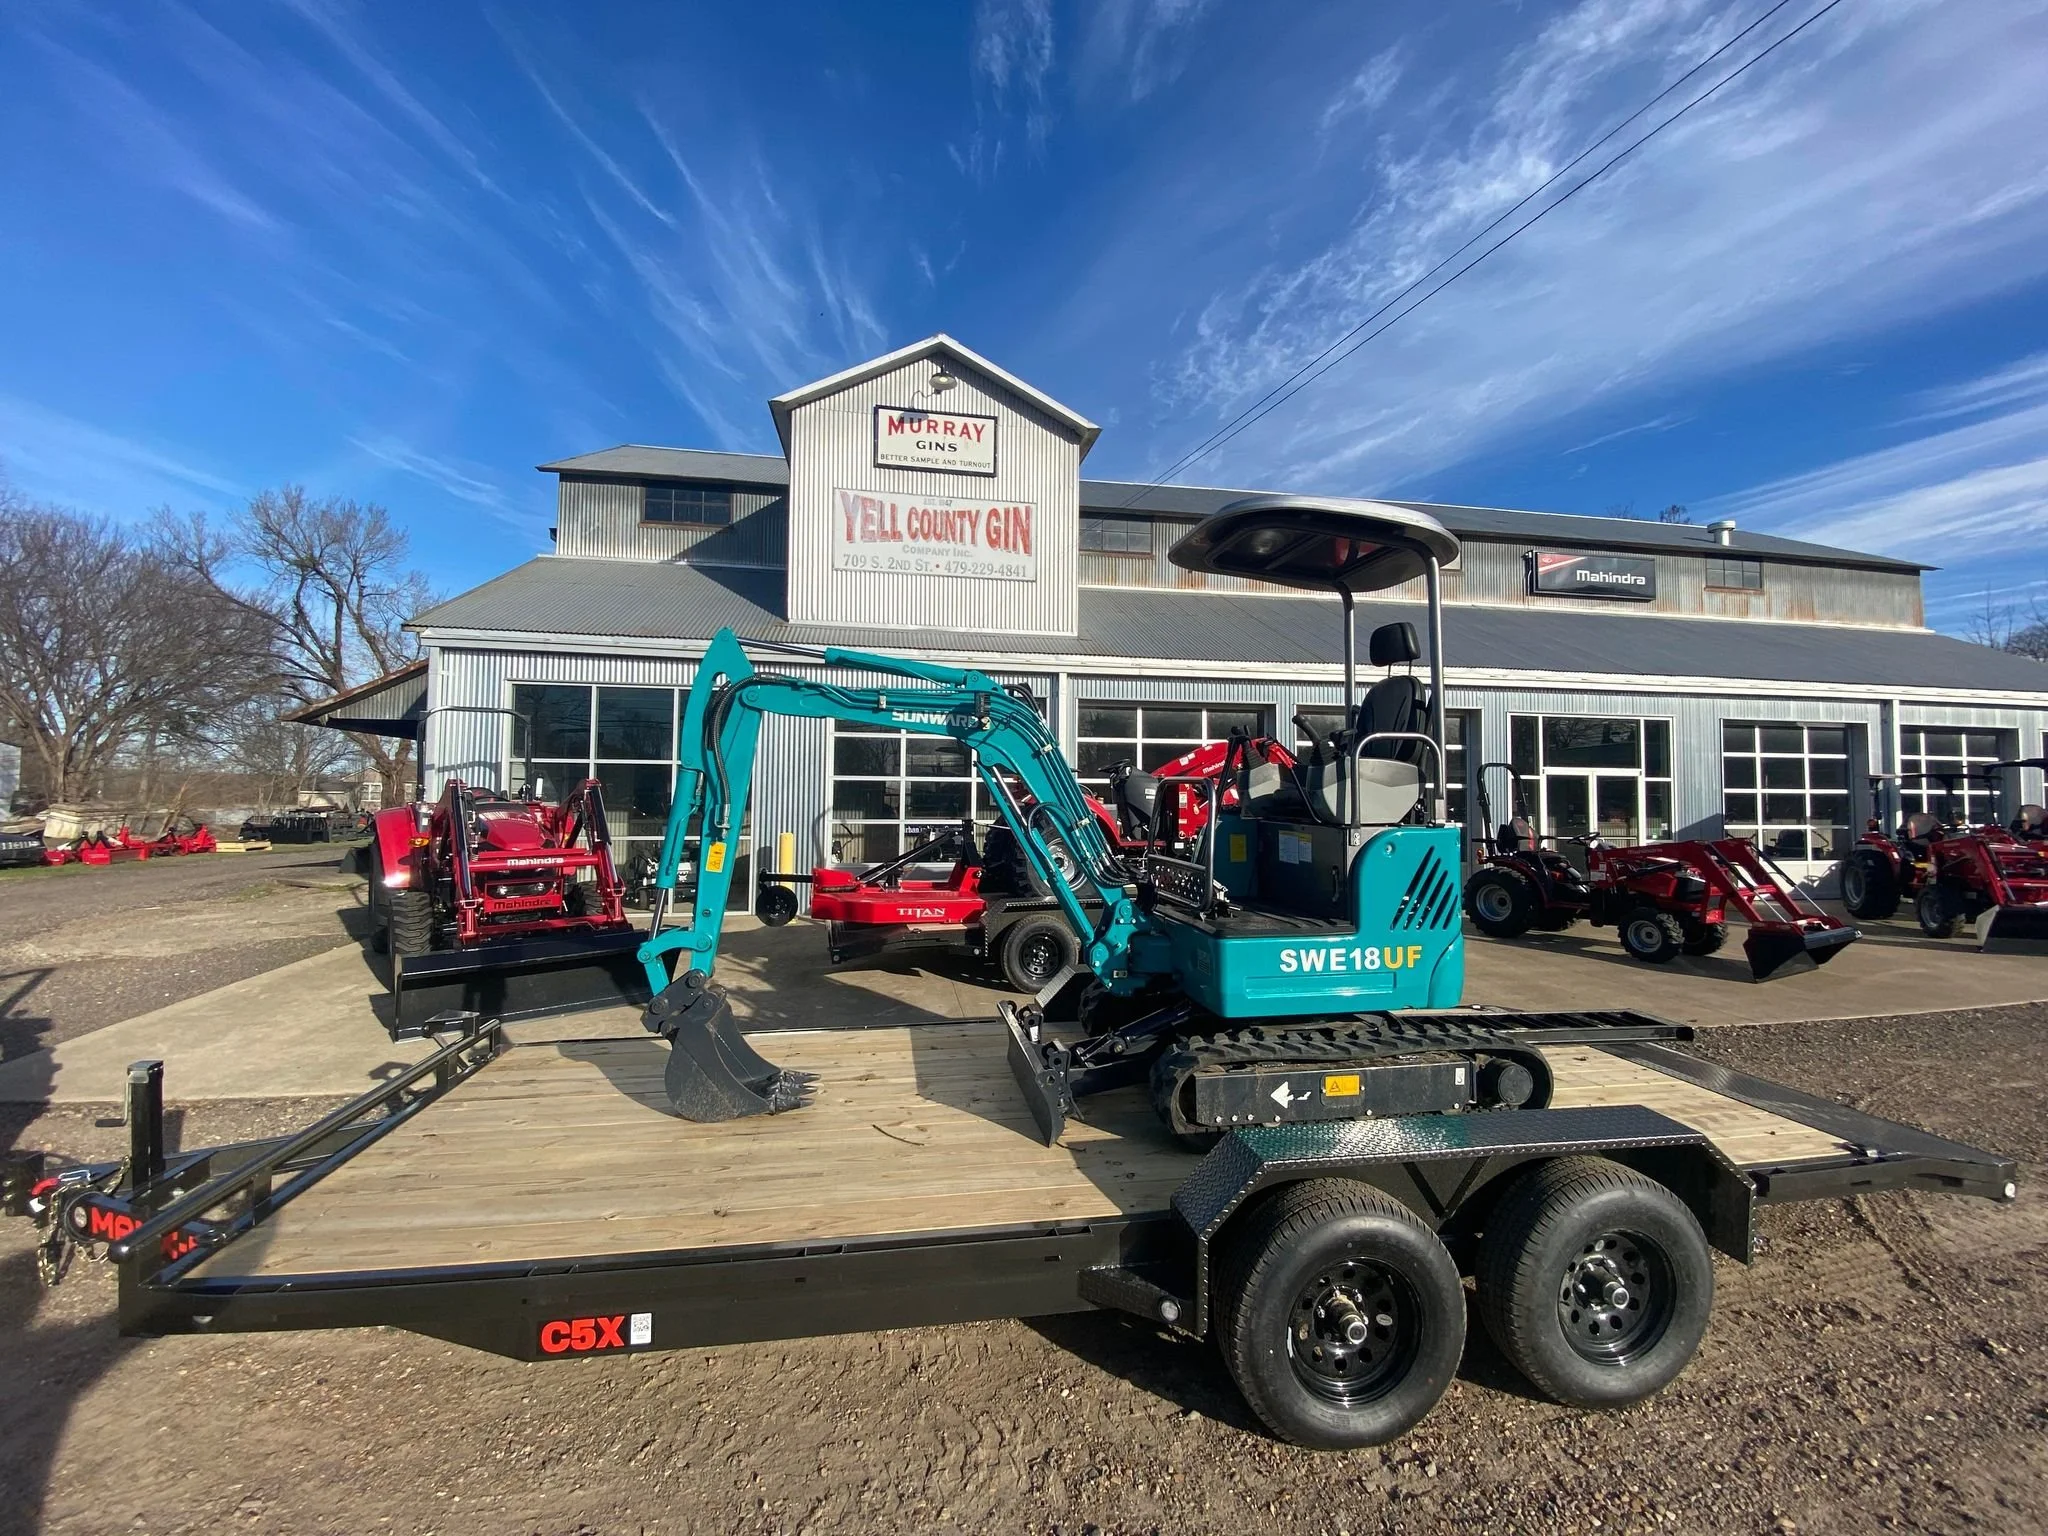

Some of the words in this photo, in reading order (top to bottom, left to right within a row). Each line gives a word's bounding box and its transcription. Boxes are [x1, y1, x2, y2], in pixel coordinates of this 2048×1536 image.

[888, 415, 986, 443] MURRAY
[916, 440, 958, 452] GINS
[880, 453, 908, 462] BETTER
[911, 456, 940, 464] SAMPLE
[960, 460, 991, 469] TURNOUT
[840, 491, 903, 543] YELL
[907, 506, 981, 546] COUNTY
[985, 505, 1032, 556] GIN
[843, 553, 867, 568] 709
[871, 555, 883, 569] S.
[944, 560, 1026, 577] 479-229-4841
[1576, 569, 1646, 585] Mahindra
[896, 907, 946, 918] TITAN
[1279, 945, 1423, 973] SWE18UF
[541, 1316, 625, 1353] C5X
